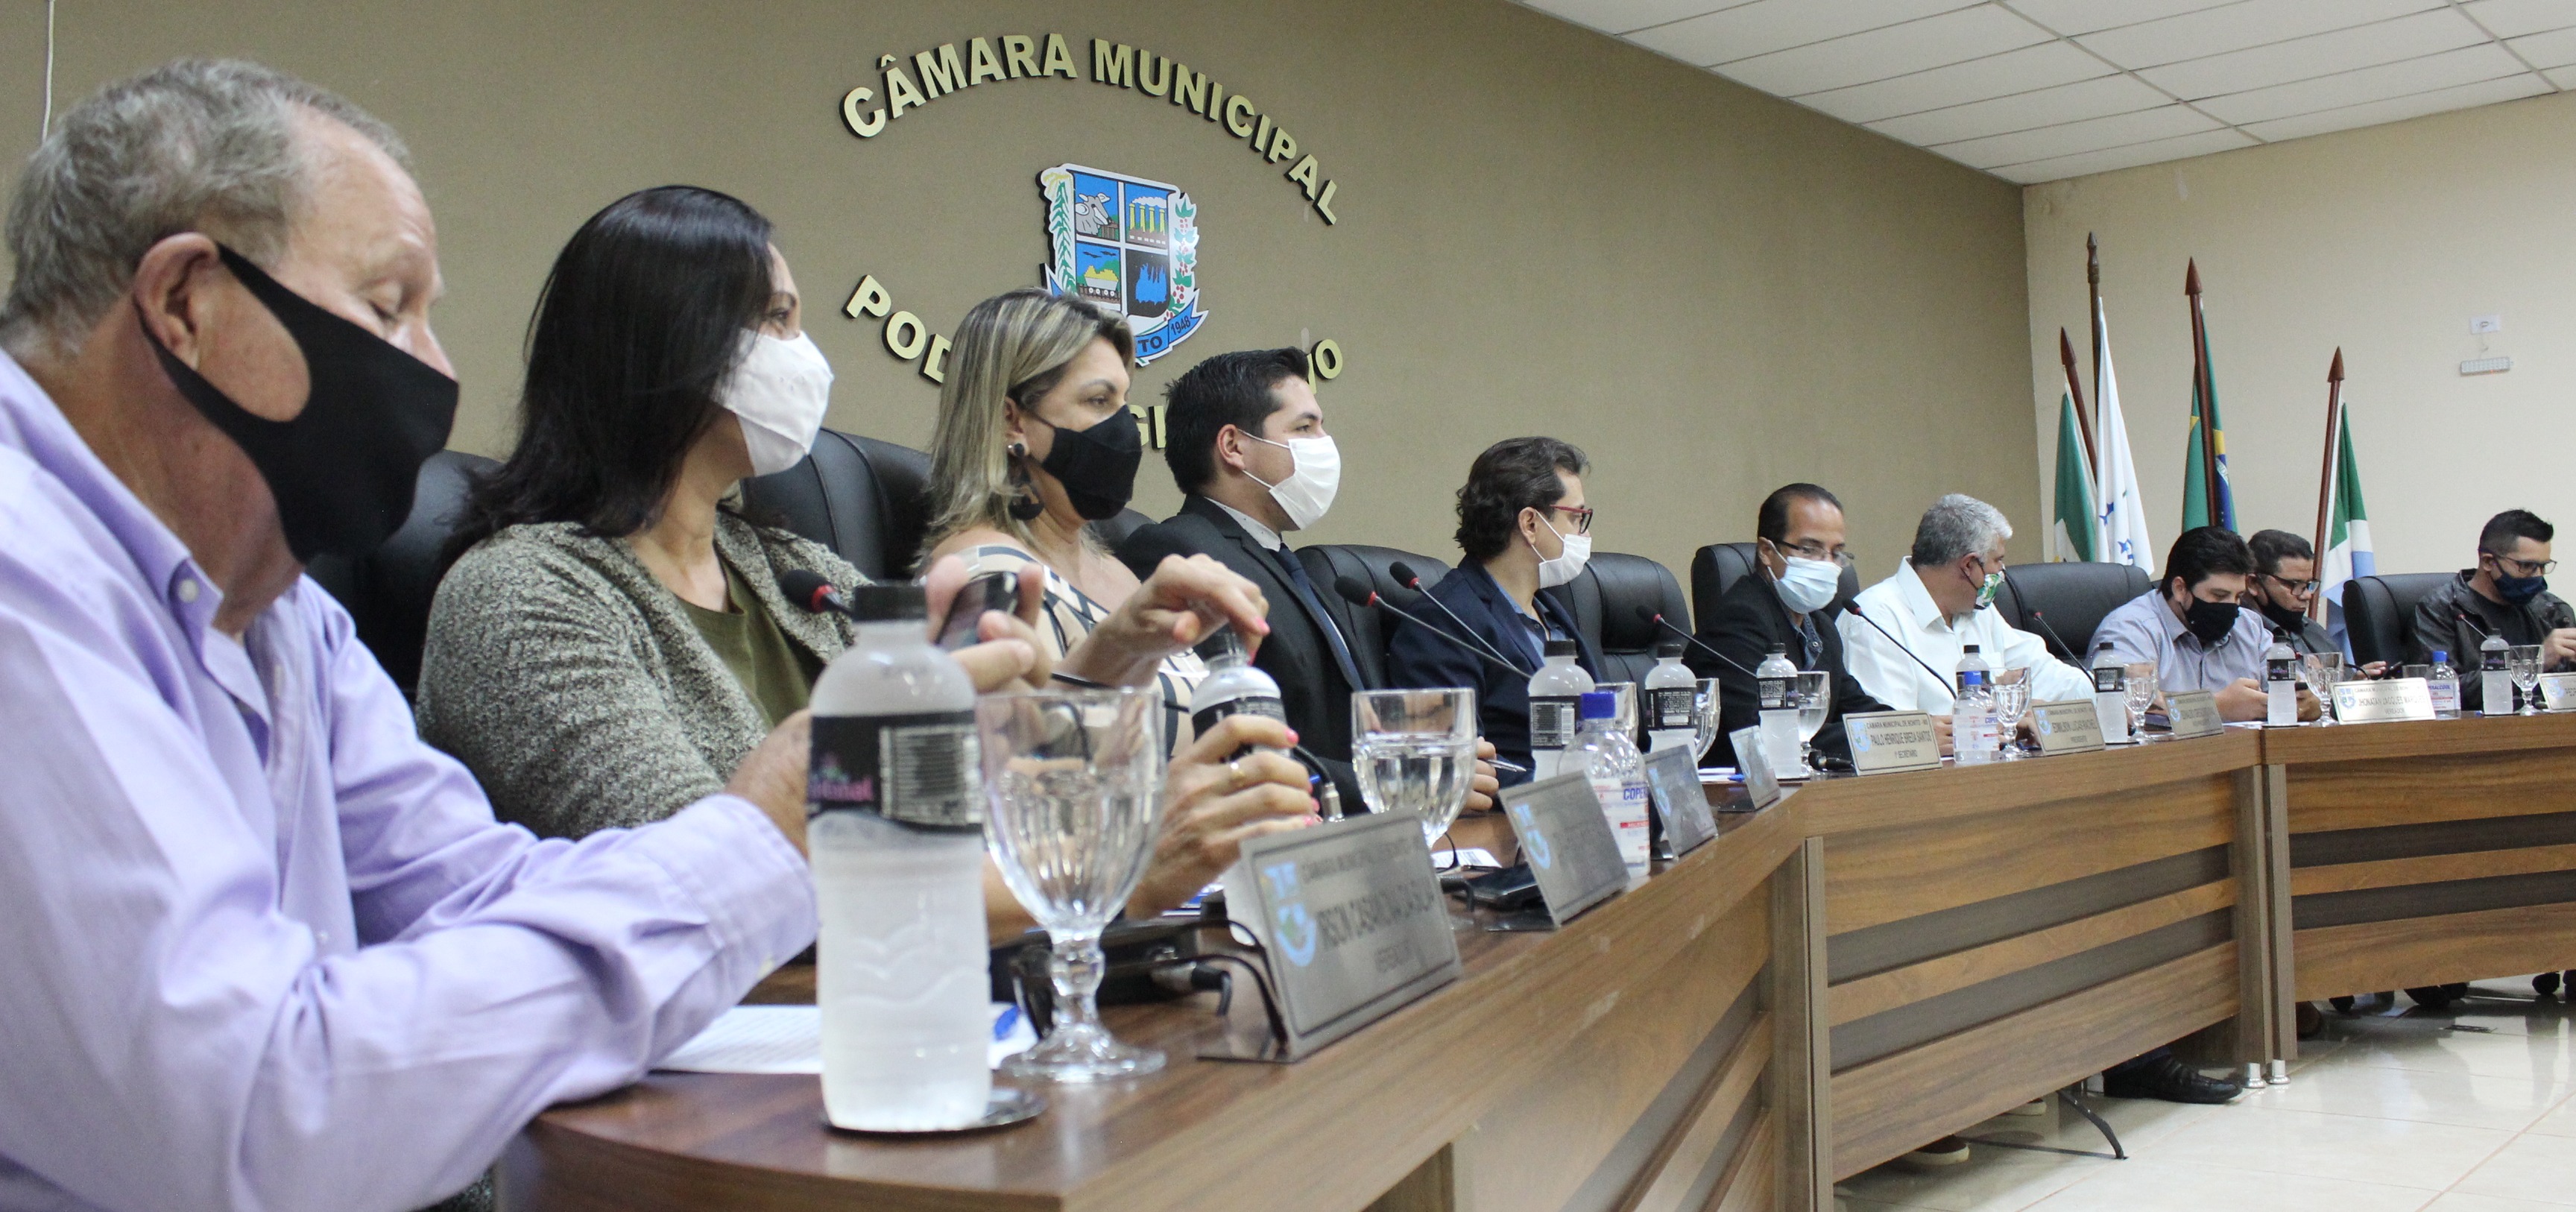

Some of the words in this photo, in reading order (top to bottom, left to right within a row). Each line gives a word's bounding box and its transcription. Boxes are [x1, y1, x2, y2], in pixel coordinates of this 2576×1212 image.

[842, 34, 1078, 139] CÂMARA
[1090, 38, 1337, 225] MUNICIPAL
[1170, 315, 1191, 335] 1948
